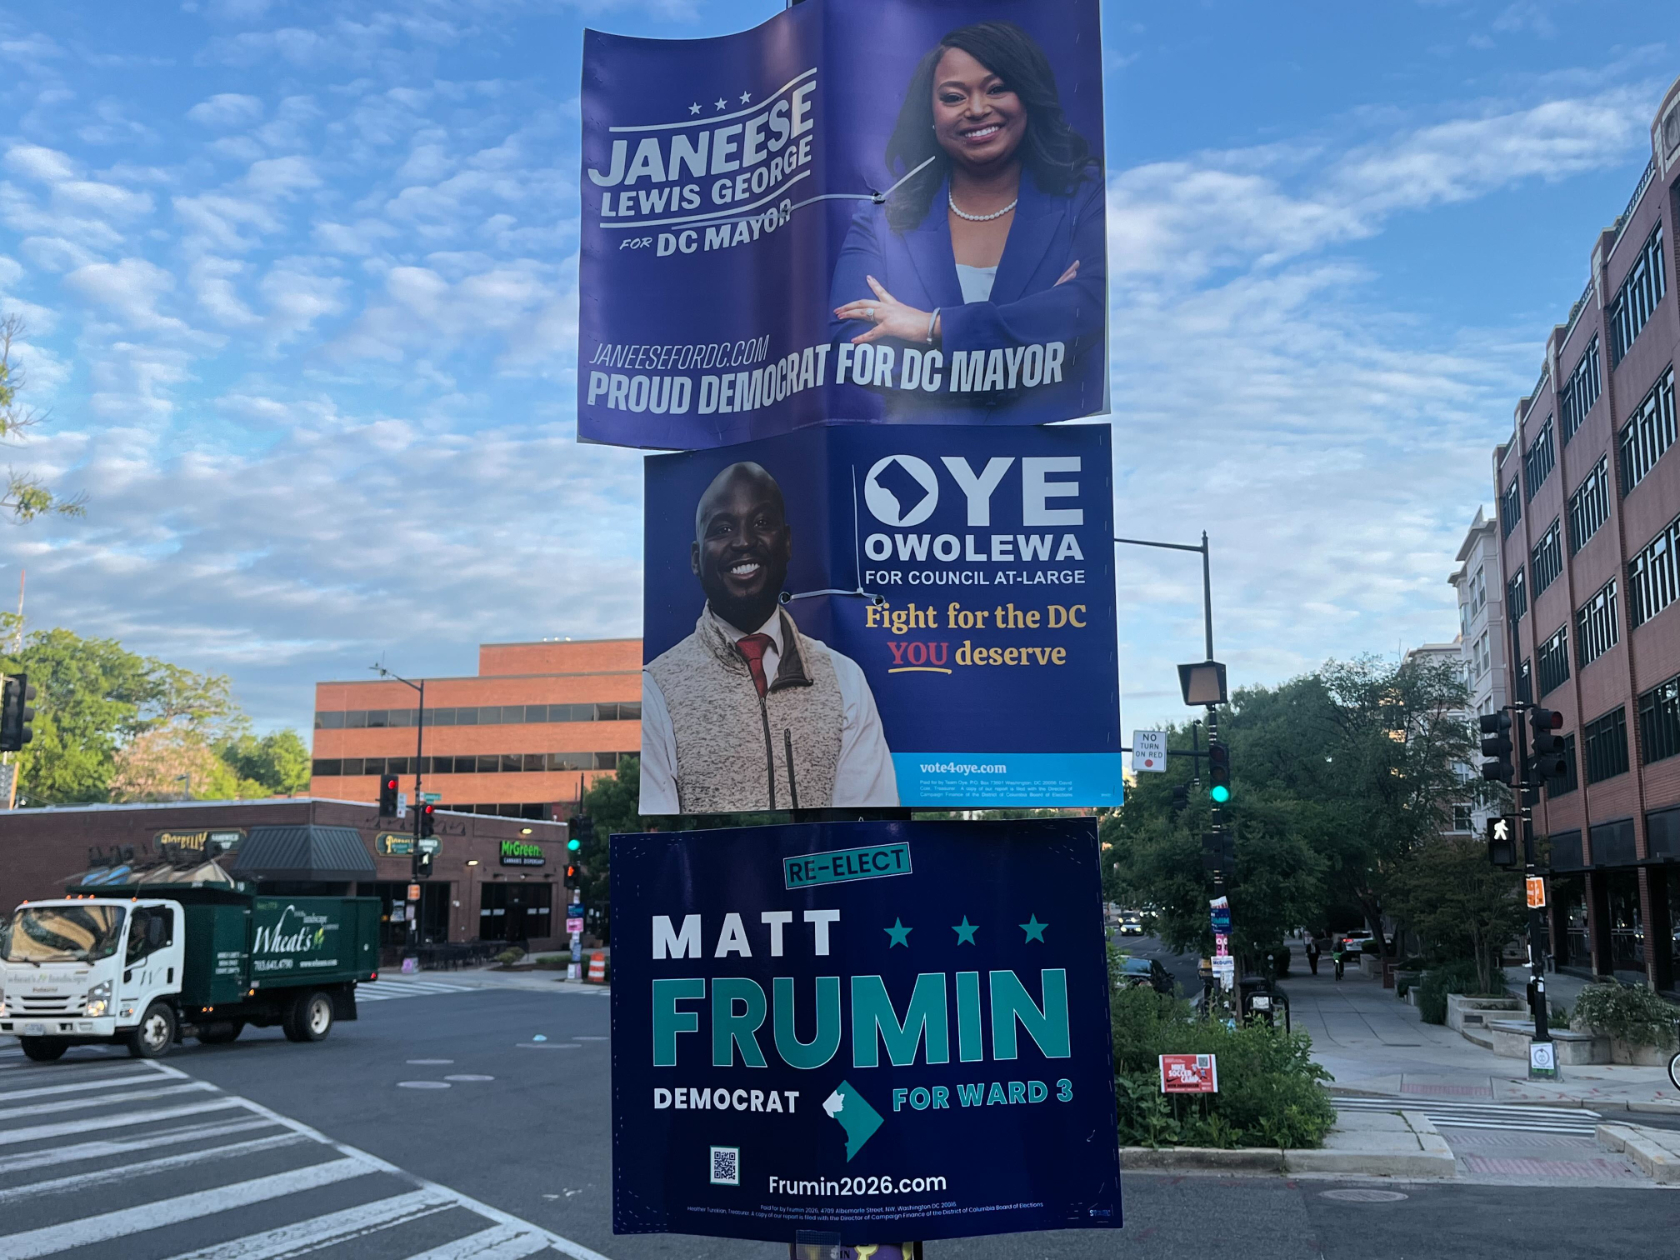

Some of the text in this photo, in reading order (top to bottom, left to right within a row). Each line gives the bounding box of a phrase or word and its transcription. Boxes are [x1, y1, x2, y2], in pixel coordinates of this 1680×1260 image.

[587, 80, 817, 187] JANEESE
[601, 134, 814, 217] LEWIS GEORGE
[619, 198, 792, 257] FOR DC MAYOR
[589, 334, 770, 370] JANEESEFORDC.COM
[587, 341, 1065, 414] PROUD DEMOCRAT FOR DC MAYOR
[864, 454, 1084, 528] OYE
[864, 533, 1085, 562] OWOLEWA
[865, 570, 1086, 585] FOR COUNCIL AT-LARGE
[865, 602, 1087, 634] Fight for the DC
[887, 640, 1067, 665] YOU deserve
[1135, 750, 1164, 759] ON RED
[1140, 742, 1160, 750] TURN
[1142, 733, 1157, 742] NO
[920, 762, 1007, 776] vote4oye.com
[789, 849, 904, 883] RE-ELECT
[252, 904, 313, 954] Wheat's
[652, 909, 841, 959] MATT
[652, 968, 1072, 1069] FRUMIN
[654, 1078, 1074, 1113] DEMOCRAT FOR WARD 3
[769, 1175, 947, 1195] Frumin2026.com
